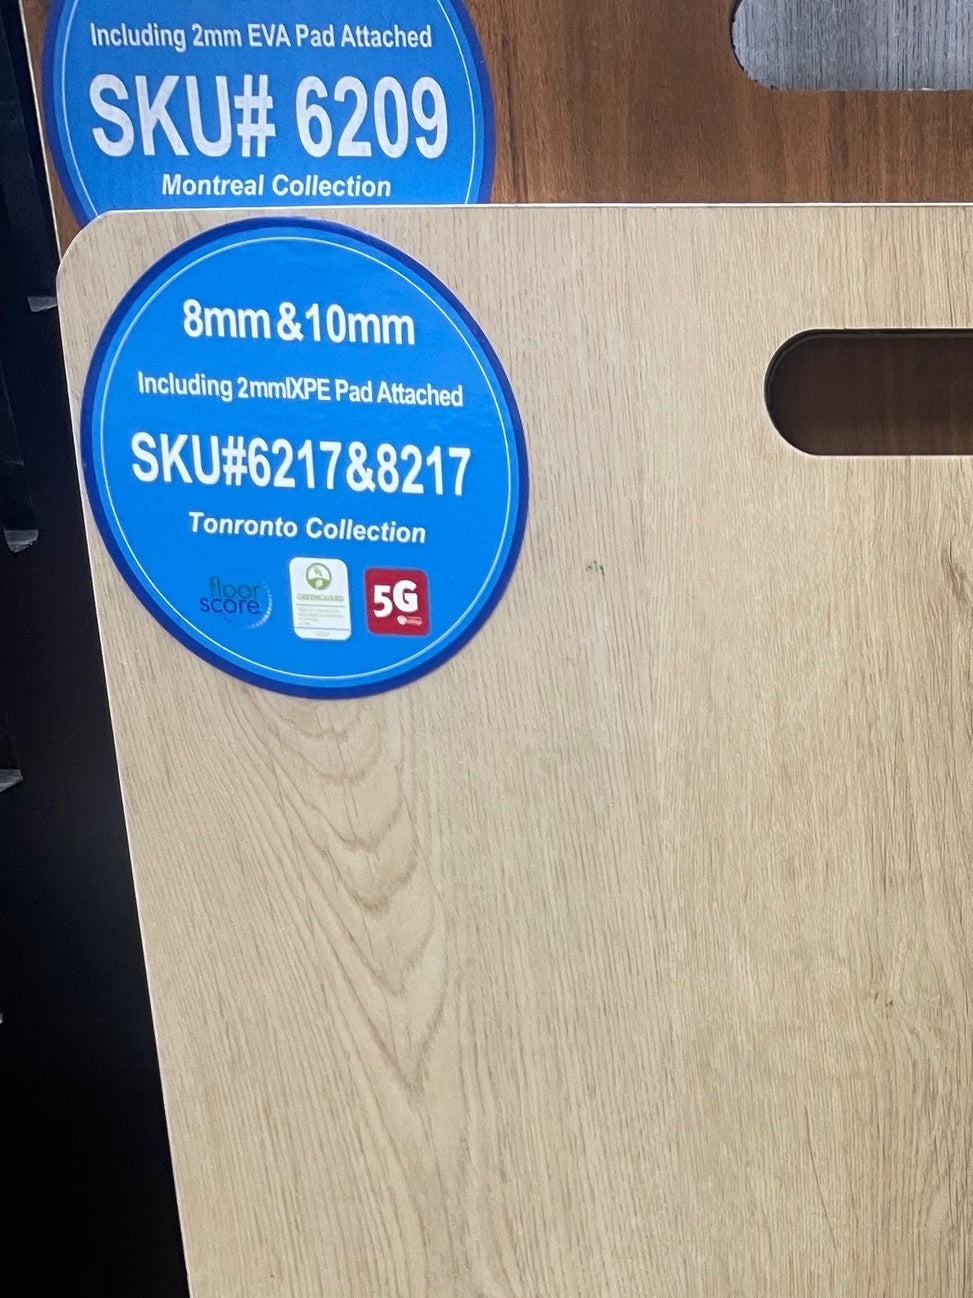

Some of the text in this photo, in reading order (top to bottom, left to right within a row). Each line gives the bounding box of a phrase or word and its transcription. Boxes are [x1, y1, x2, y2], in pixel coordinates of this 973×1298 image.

[90, 22, 433, 53] Including 2mm EVA Pad Attached
[89, 73, 449, 159] SKU# 6209
[161, 173, 392, 197] Montreal Collection
[137, 370, 233, 402] Including
[334, 378, 373, 402] Pad
[376, 380, 464, 407] Attached
[131, 431, 472, 496] SKU#6217&8217
[188, 511, 426, 544] Tonronto Collection
[199, 597, 261, 615] score
[373, 579, 419, 618] 5G
